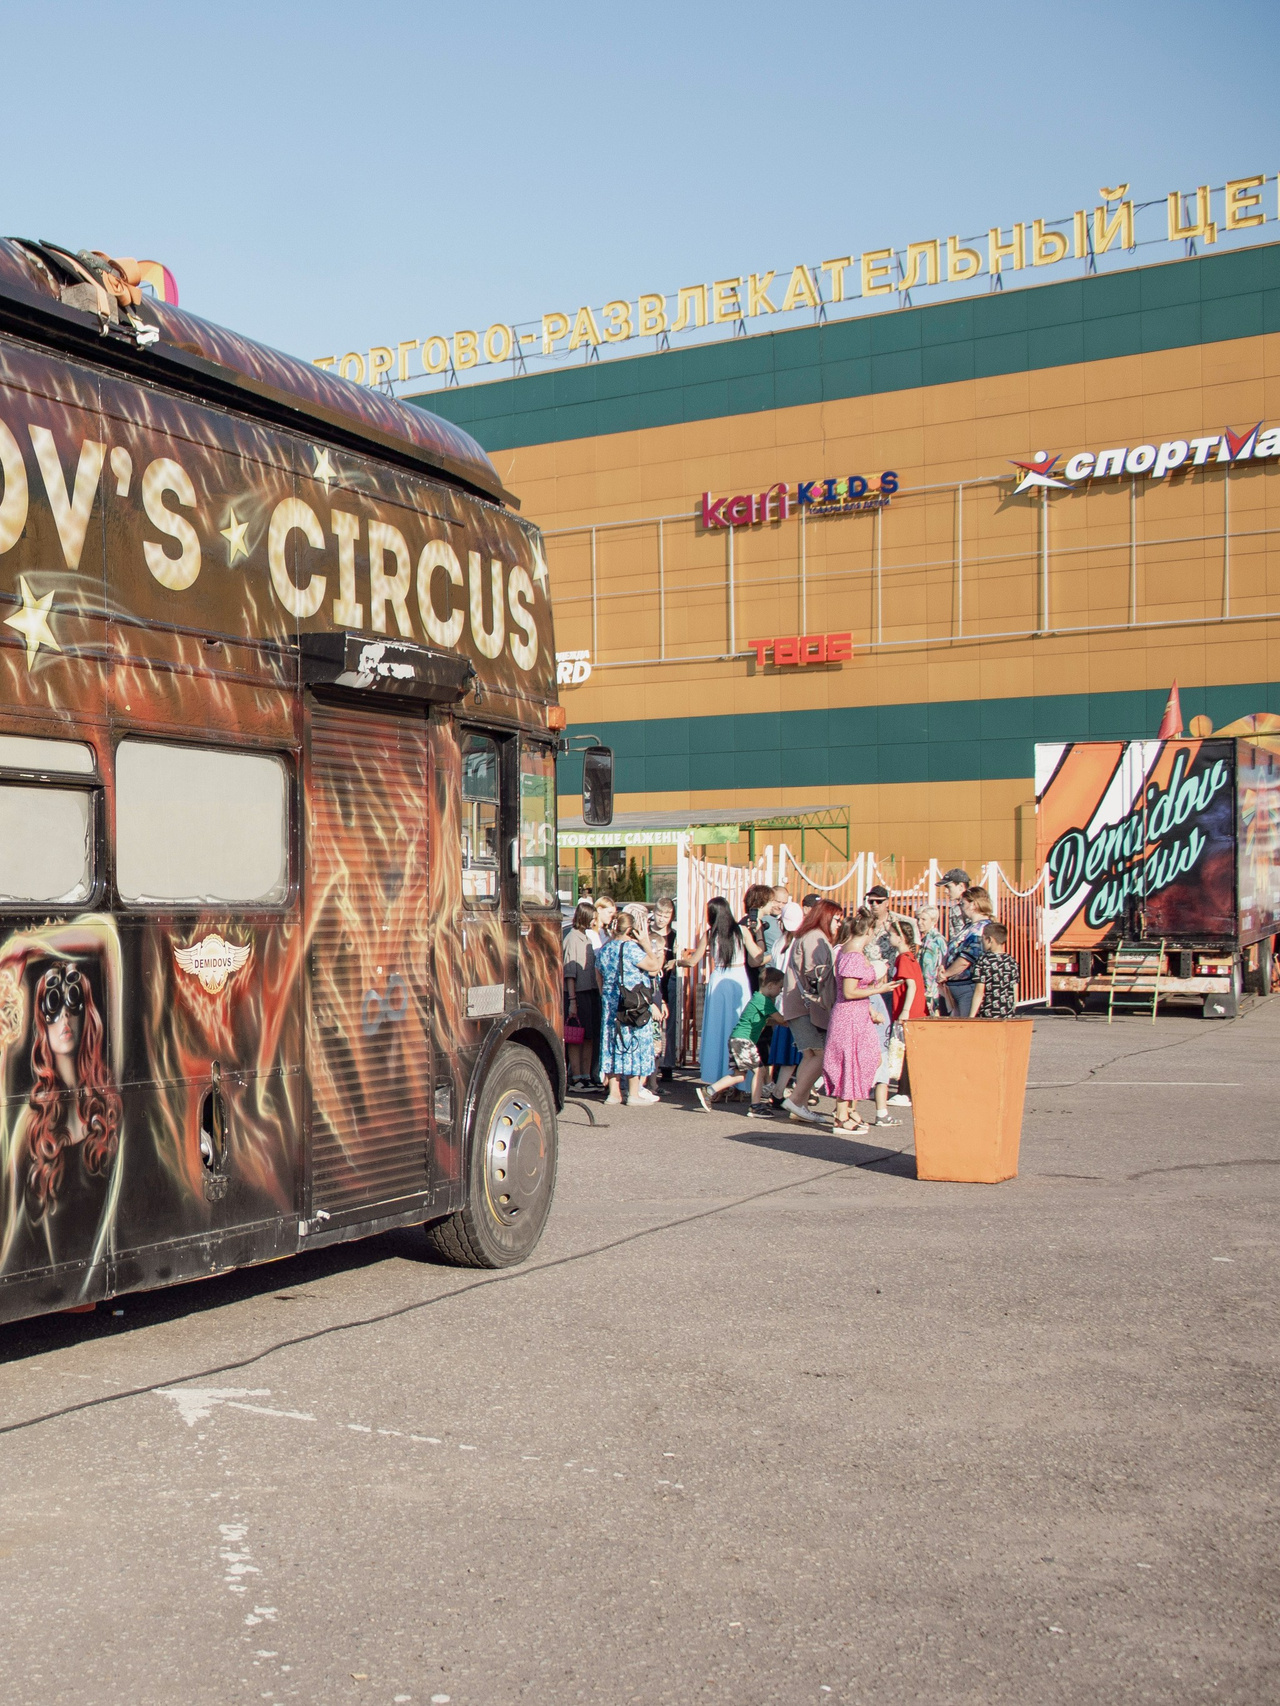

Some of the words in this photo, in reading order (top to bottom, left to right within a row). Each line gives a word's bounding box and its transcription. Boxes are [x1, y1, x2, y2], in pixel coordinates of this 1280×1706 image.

[1168, 171, 1280, 245] ЦЕ
[702, 482, 790, 528] kari
[797, 471, 899, 505] KIDS
[268, 497, 538, 671] CIRCUS
[748, 633, 854, 666] ТВОЕ
[1050, 755, 1228, 904] Demidov
[194, 957, 232, 969] DEMIDOVS
